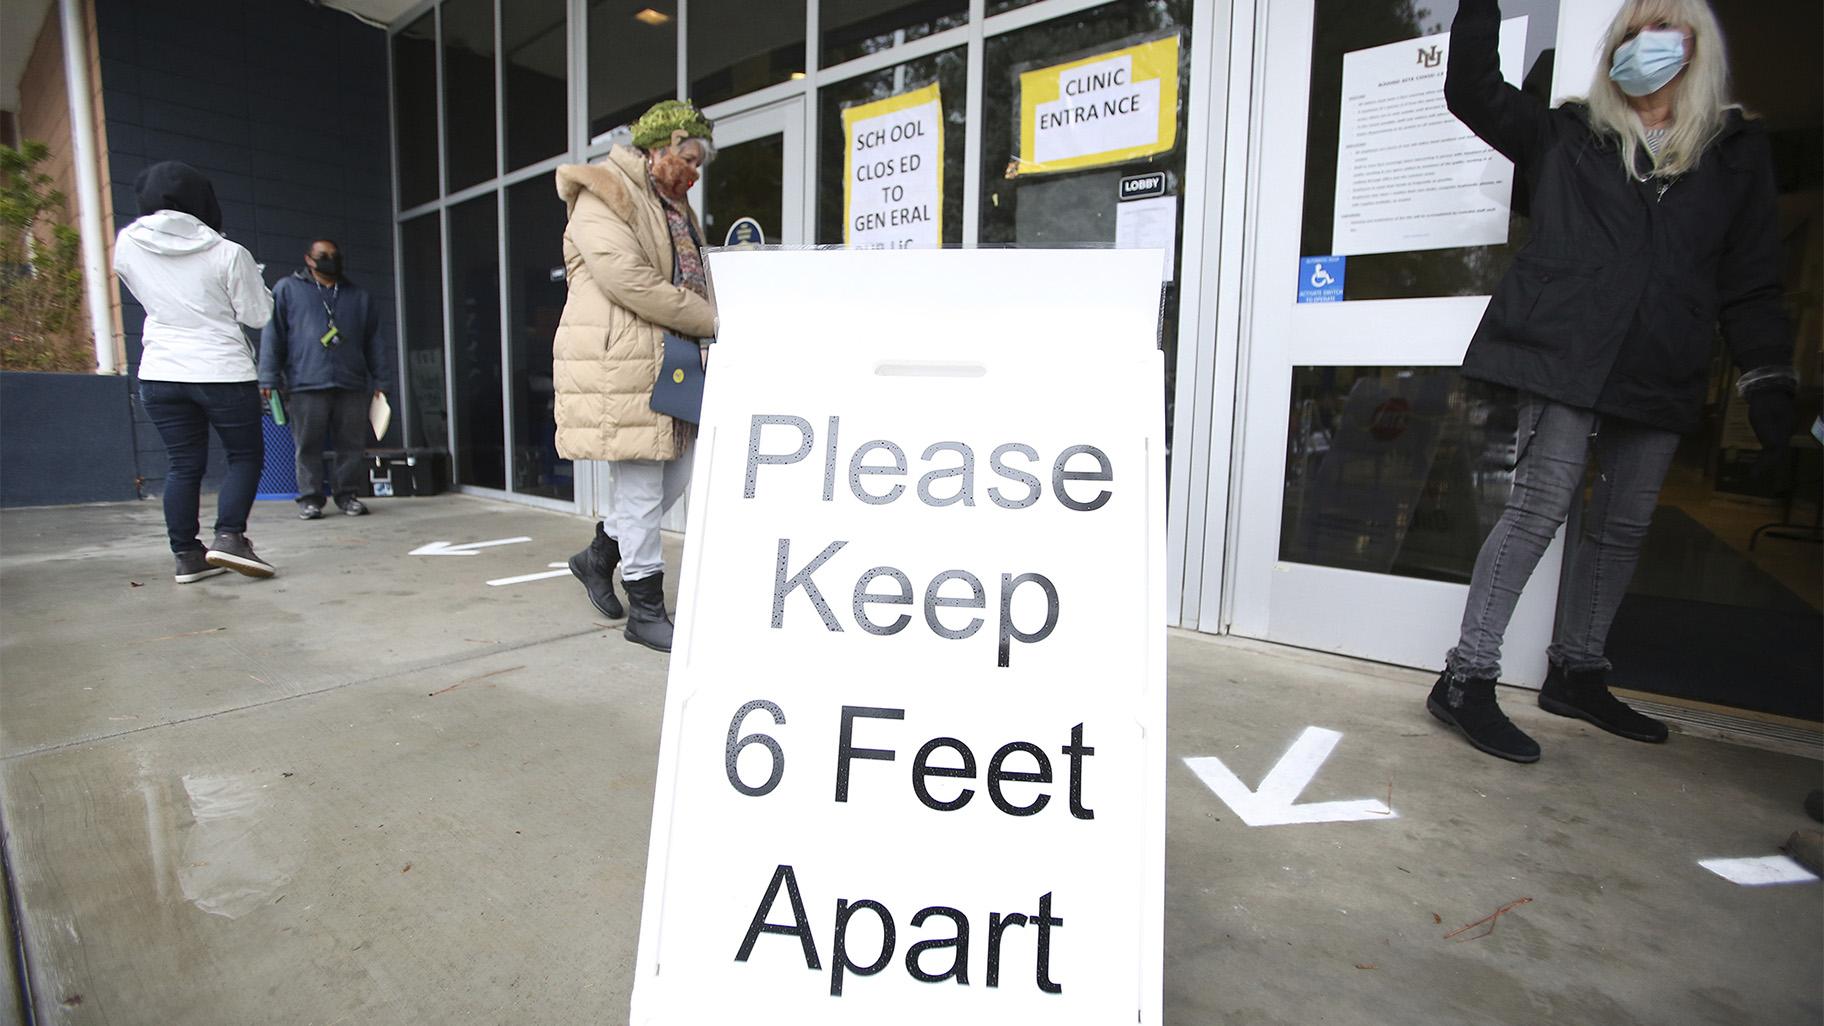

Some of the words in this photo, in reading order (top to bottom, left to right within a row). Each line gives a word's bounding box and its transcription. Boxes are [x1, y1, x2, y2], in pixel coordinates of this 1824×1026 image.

[1040, 94, 1140, 130] ENTRANCE
[1065, 68, 1126, 97] CLINIC
[882, 184, 904, 204] TO
[1125, 177, 1160, 192] LOBBY
[743, 414, 1114, 512] Please
[770, 538, 1060, 668] Keep
[724, 699, 787, 798] 6
[834, 705, 1095, 821] Feet
[733, 864, 1064, 998] Apart
